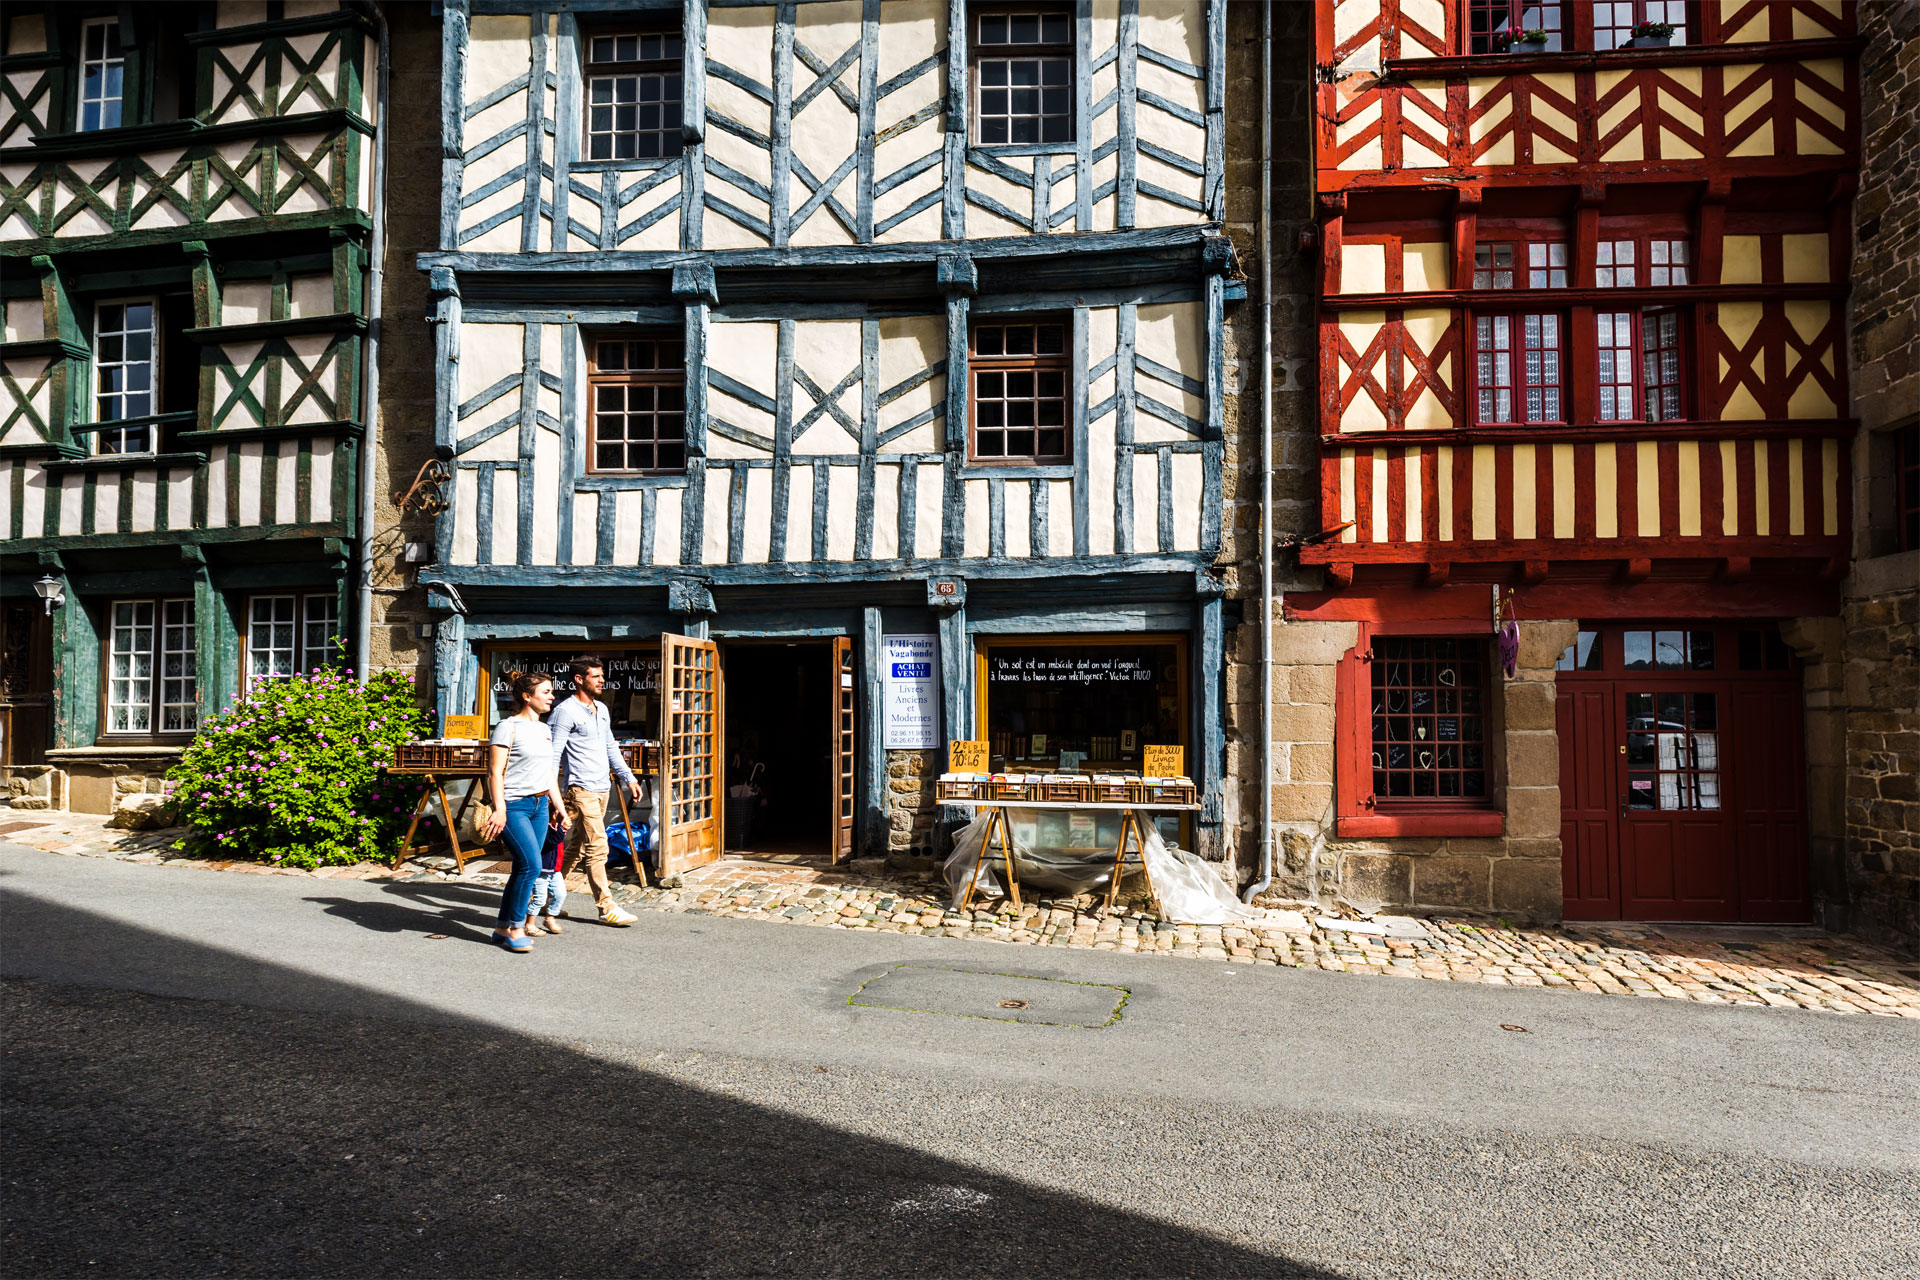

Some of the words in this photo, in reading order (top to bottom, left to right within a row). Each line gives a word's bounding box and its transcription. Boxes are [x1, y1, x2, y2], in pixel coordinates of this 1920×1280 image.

[940, 585, 952, 593] 65
[890, 639, 934, 648] L'Histoire
[890, 649, 934, 658] Vagabonde
[631, 655, 646, 671] des
[1011, 657, 1024, 669] sot
[1025, 657, 1035, 669] est
[1048, 657, 1074, 669] imbécile
[1076, 659, 1090, 669] dont
[1100, 658, 1112, 669] voit
[1113, 657, 1140, 672] l'orgueil
[990, 670, 996, 681] à
[998, 669, 1020, 681] travers
[1022, 671, 1032, 681] les
[1032, 671, 1047, 681] trous
[1049, 672, 1056, 681] de
[1109, 670, 1130, 681] Victor
[1133, 669, 1151, 681] HUGO
[899, 685, 925, 694] Livres
[895, 695, 928, 704] Anciens
[891, 713, 932, 722] Modernes
[1158, 745, 1165, 755] de
[973, 754, 980, 767] 6
[1152, 754, 1176, 763] Livres
[1147, 763, 1155, 771] de
[1157, 762, 1176, 772] Poche
